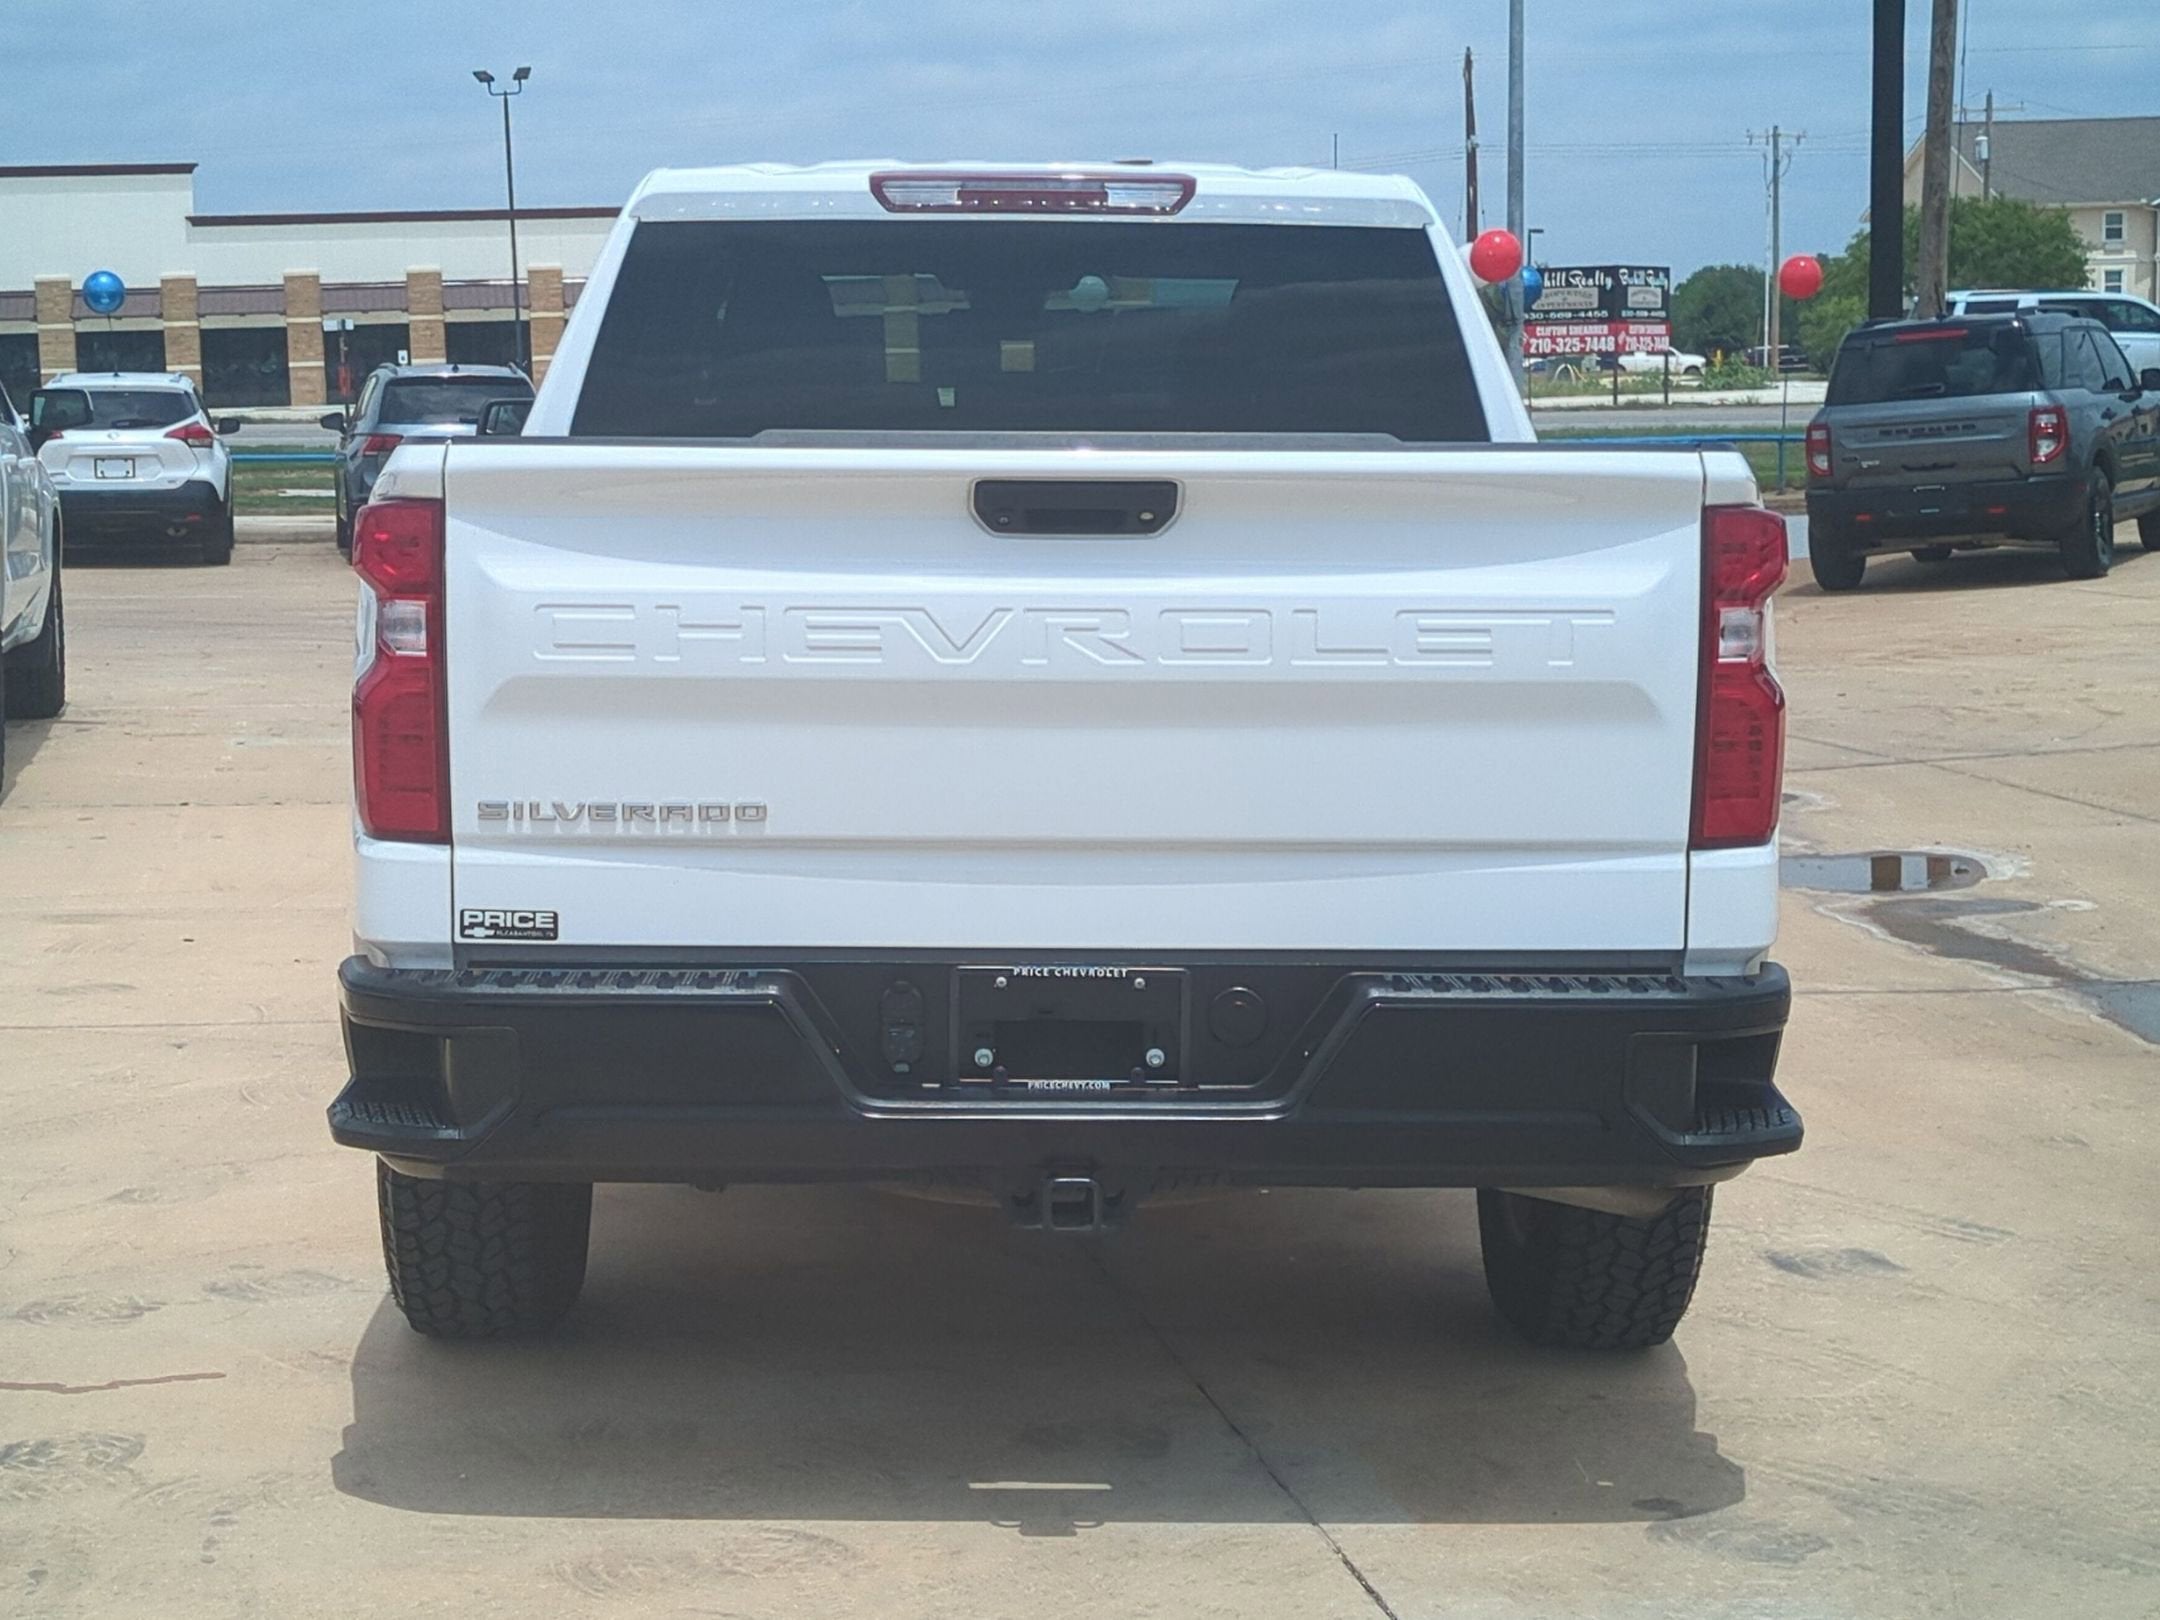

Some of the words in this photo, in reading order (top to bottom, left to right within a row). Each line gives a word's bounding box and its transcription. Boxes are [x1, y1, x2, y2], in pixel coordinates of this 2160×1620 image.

[1529, 336, 1615, 354] 210-325-7448
[534, 603, 1616, 666] CHEVROLET
[477, 801, 768, 823] SILVERADO
[463, 910, 555, 929] PRICE
[1013, 966, 1049, 977] PRICE
[1054, 967, 1128, 978] CHEVROLET
[1027, 1080, 1111, 1091] PRICECHEVY.COM
